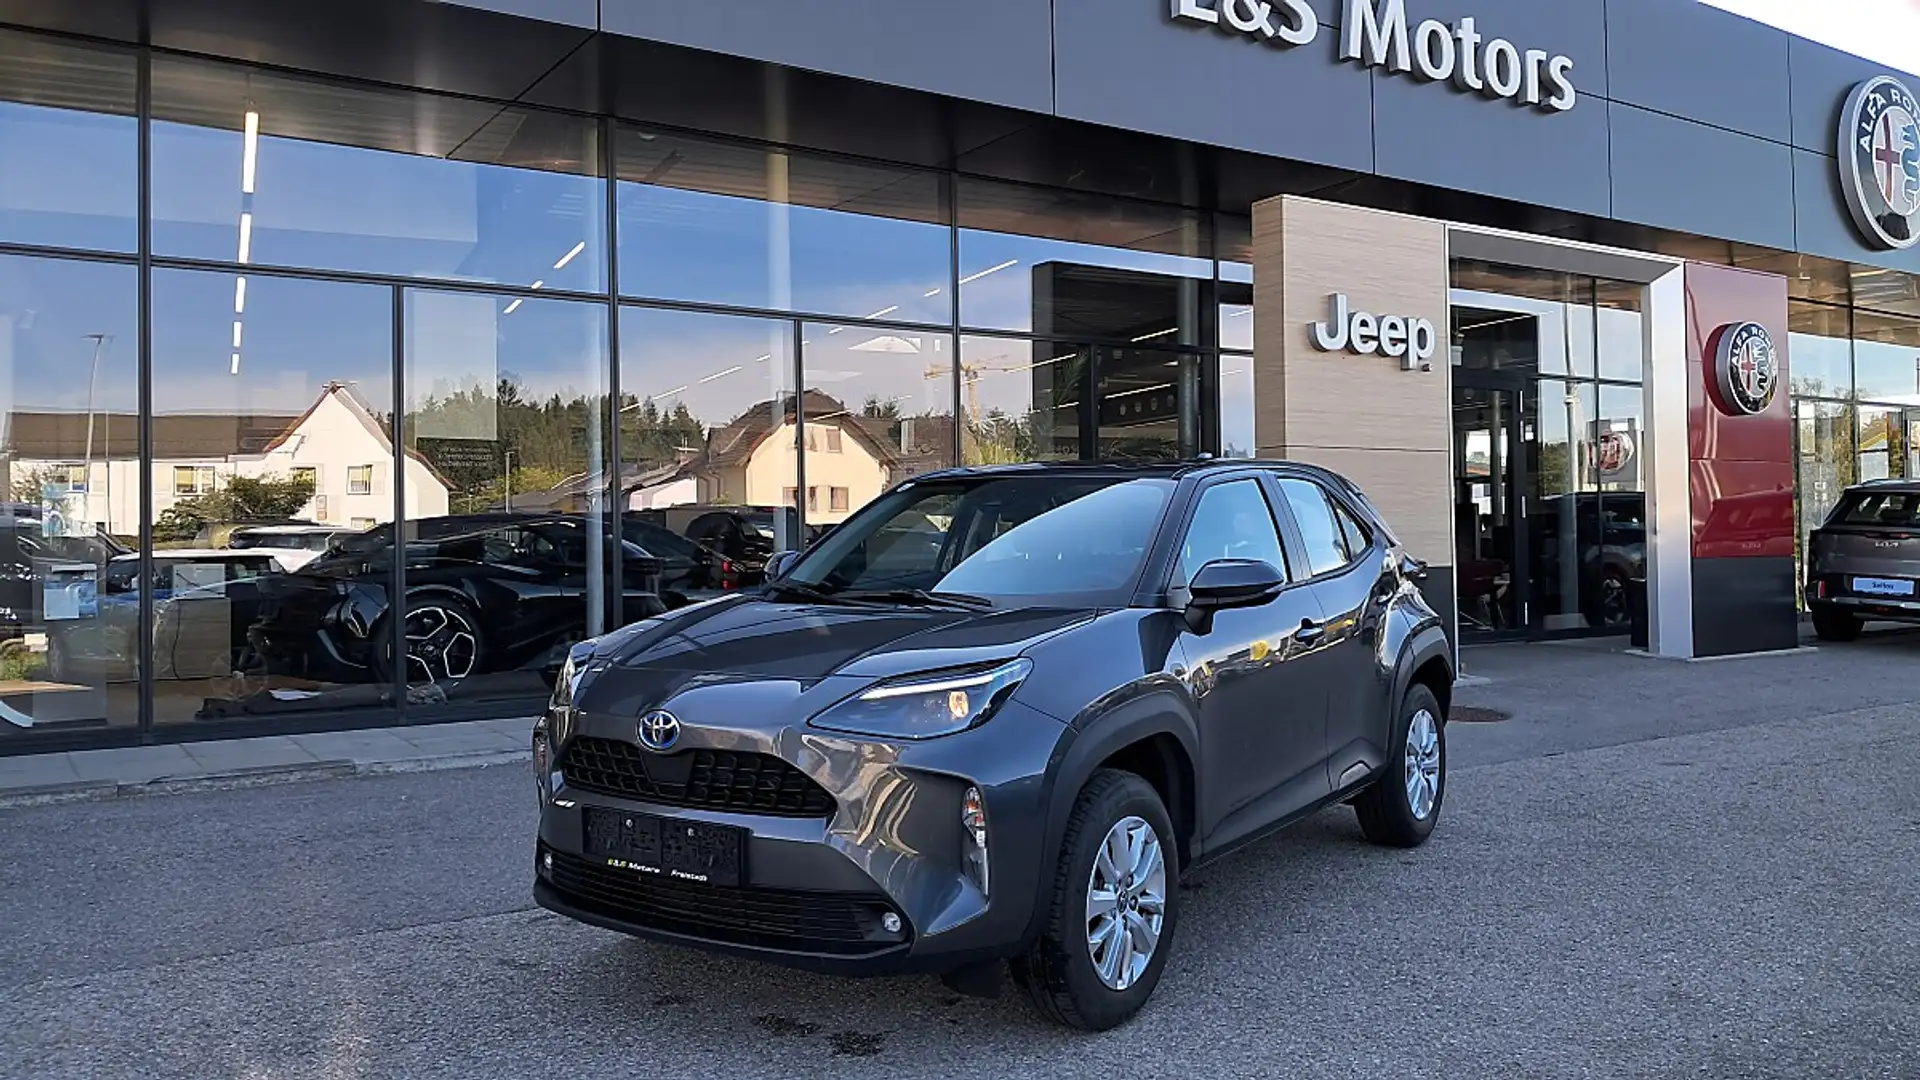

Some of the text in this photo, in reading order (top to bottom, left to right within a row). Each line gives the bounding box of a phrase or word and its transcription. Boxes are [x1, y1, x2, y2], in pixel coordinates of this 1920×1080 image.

[1170, 0, 1576, 111] &S Motors
[1859, 93, 1887, 153] ALFA
[1309, 292, 1436, 370] Jeep
